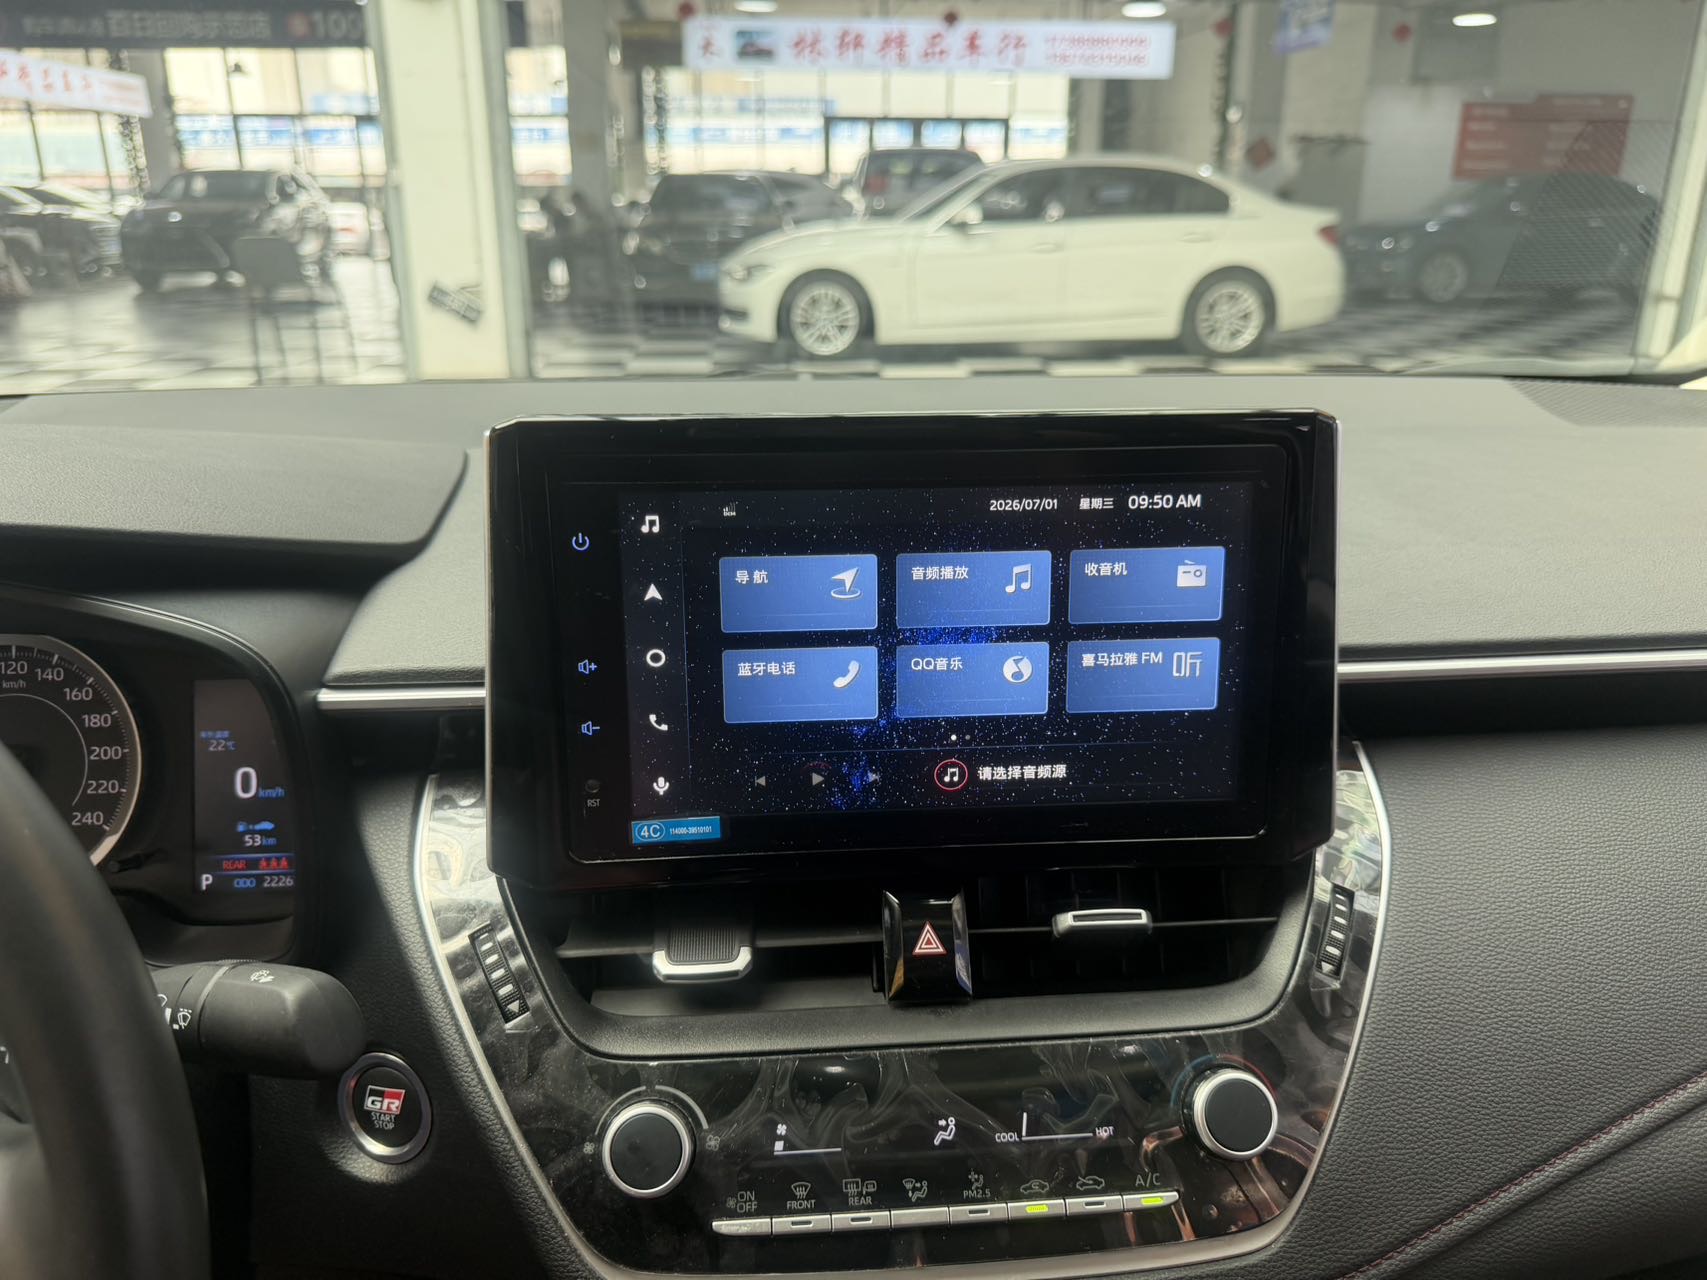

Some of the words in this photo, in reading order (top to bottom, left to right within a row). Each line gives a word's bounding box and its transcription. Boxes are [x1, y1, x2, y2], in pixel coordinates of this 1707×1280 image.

[989, 498, 1058, 512] 2026/07/01
[1079, 497, 1114, 510] 星期三
[1128, 494, 1173, 510] 09:50
[1175, 493, 1202, 509] AM
[911, 565, 969, 580] 音频播放
[1084, 562, 1128, 576] 收音机
[735, 569, 769, 584] 导航
[911, 657, 963, 671] QQ音乐
[1081, 652, 1138, 667] 喜马拉雅
[1141, 651, 1163, 664] FM
[0, 660, 28, 675] 120
[35, 667, 64, 682] 140
[737, 661, 796, 676] 蓝牙电话
[2, 679, 26, 689] km/h
[63, 687, 93, 701] 160
[82, 713, 112, 728] 180
[90, 746, 122, 760] 200
[978, 764, 1067, 780] 请选择音频源
[87, 780, 119, 794] 220
[234, 767, 258, 799] 0
[258, 787, 285, 797] km/h
[587, 799, 600, 807] RST
[71, 811, 104, 826] 240
[640, 824, 660, 838] 4C
[244, 835, 262, 847] 53
[262, 837, 277, 845] km
[222, 860, 248, 870] REAR
[201, 873, 213, 890] P
[263, 876, 294, 887] 2226
[367, 1096, 400, 1111] GR
[371, 1112, 395, 1122] START
[374, 1120, 395, 1130] STOP
[995, 1132, 1019, 1142] COOL
[1095, 1126, 1114, 1136] HOT
[1135, 1172, 1161, 1187] A/C
[737, 1191, 755, 1201] ON
[848, 1196, 872, 1206] REAR
[963, 1189, 991, 1199] PM2.5
[736, 1201, 757, 1213] OFF
[786, 1199, 816, 1210] FRONT
